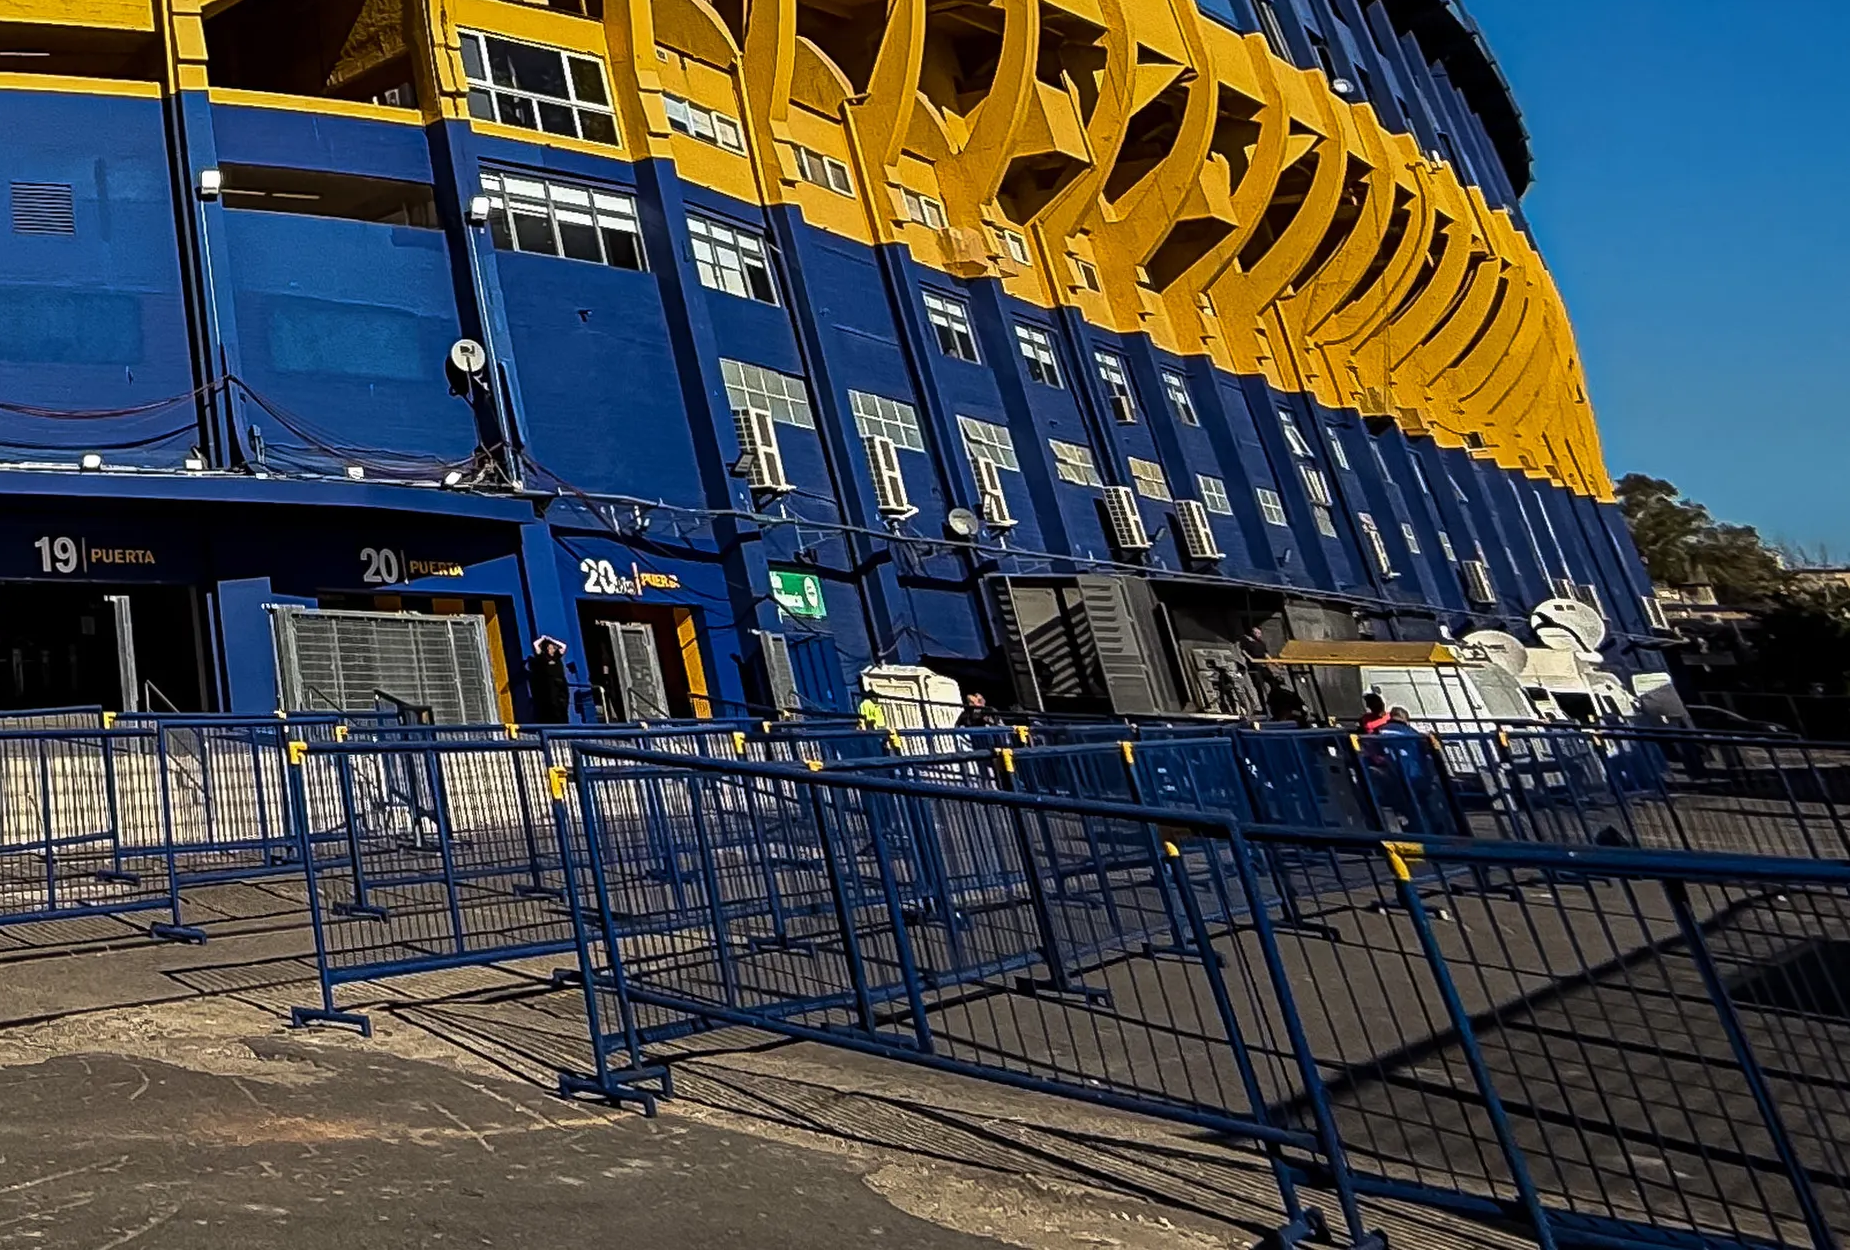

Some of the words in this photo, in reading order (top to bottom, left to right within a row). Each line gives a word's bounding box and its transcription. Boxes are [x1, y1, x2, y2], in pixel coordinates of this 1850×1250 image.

[34, 536, 78, 573] 19
[90, 548, 156, 564] PUERTA
[360, 547, 399, 584] 20
[409, 560, 464, 577] PUERTA
